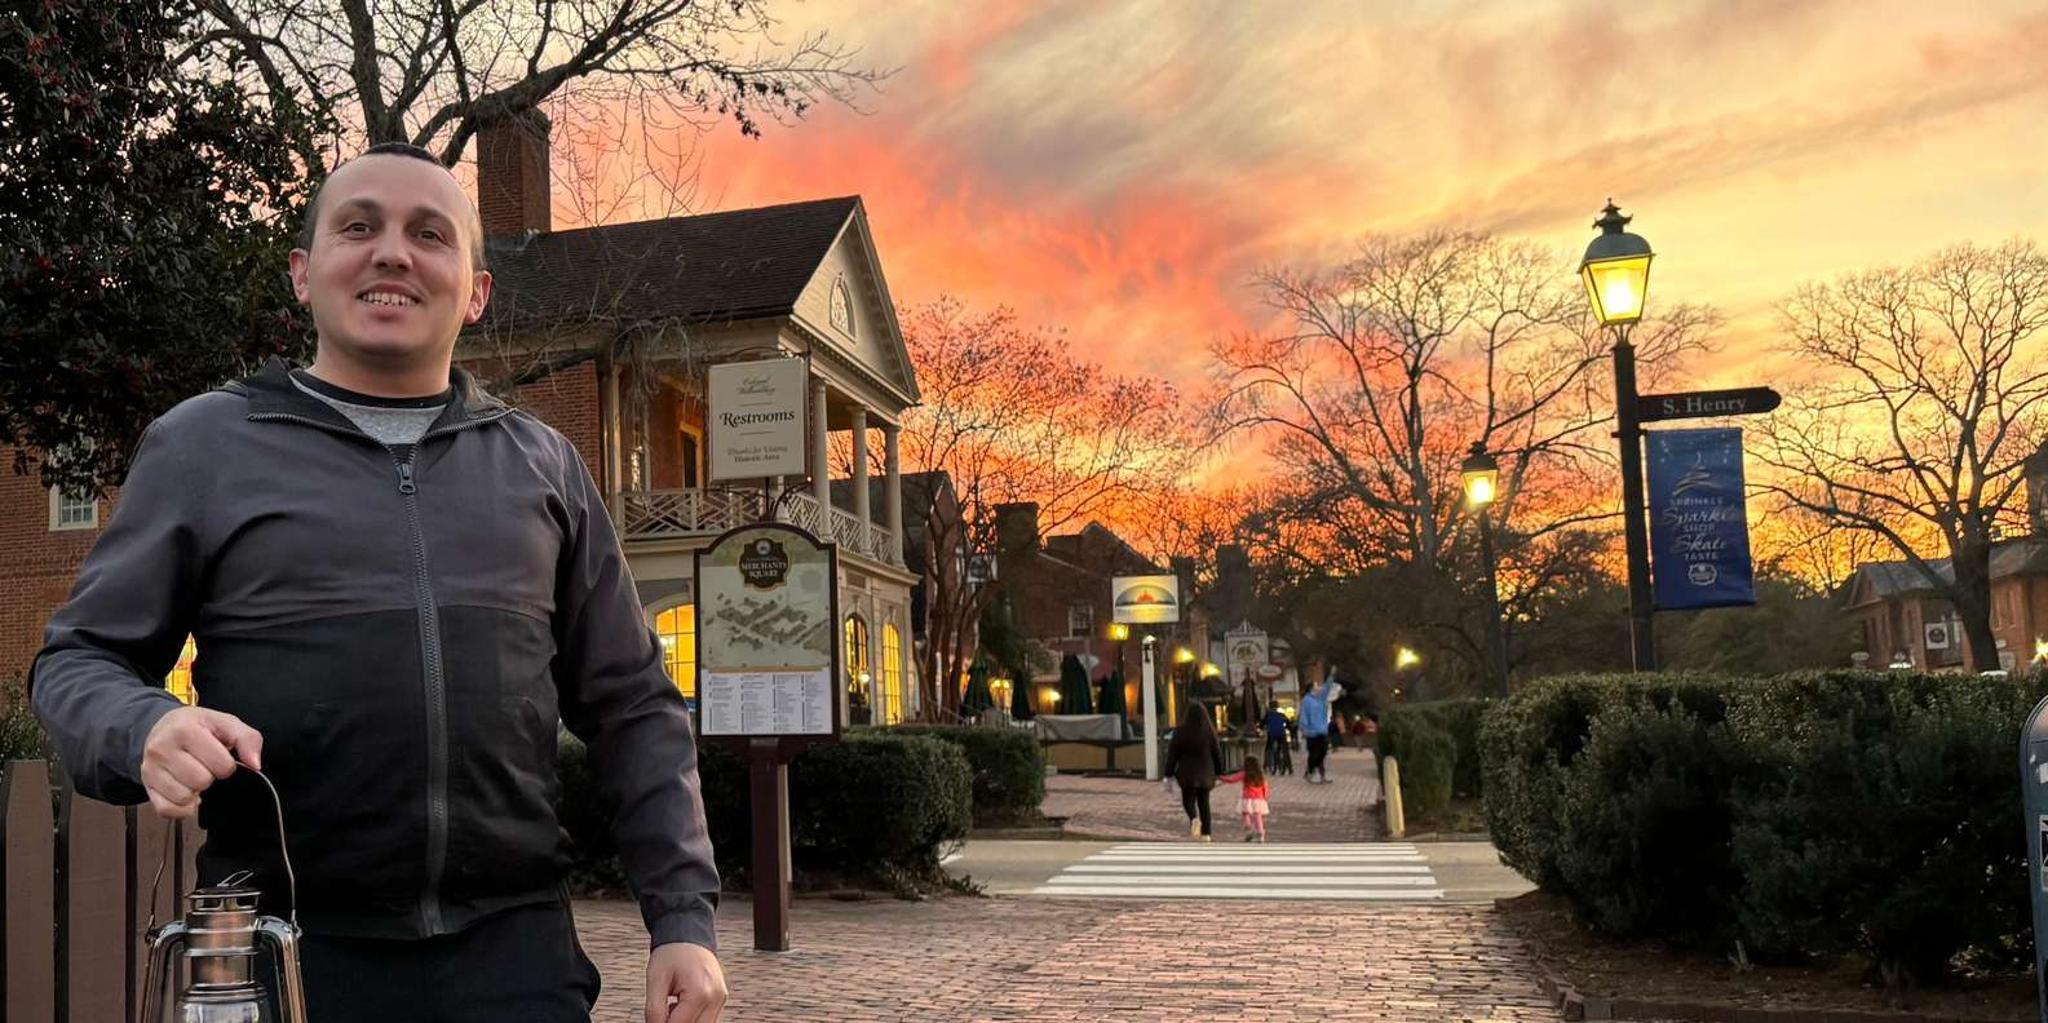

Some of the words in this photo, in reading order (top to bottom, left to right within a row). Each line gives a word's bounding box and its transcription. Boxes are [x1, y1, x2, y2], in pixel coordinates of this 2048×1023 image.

[1663, 398, 1680, 415] S.
[1686, 396, 1747, 414] Henry
[719, 410, 796, 428] Restrooms
[1671, 533, 1728, 553] Skate
[1684, 551, 1719, 560] TASTE
